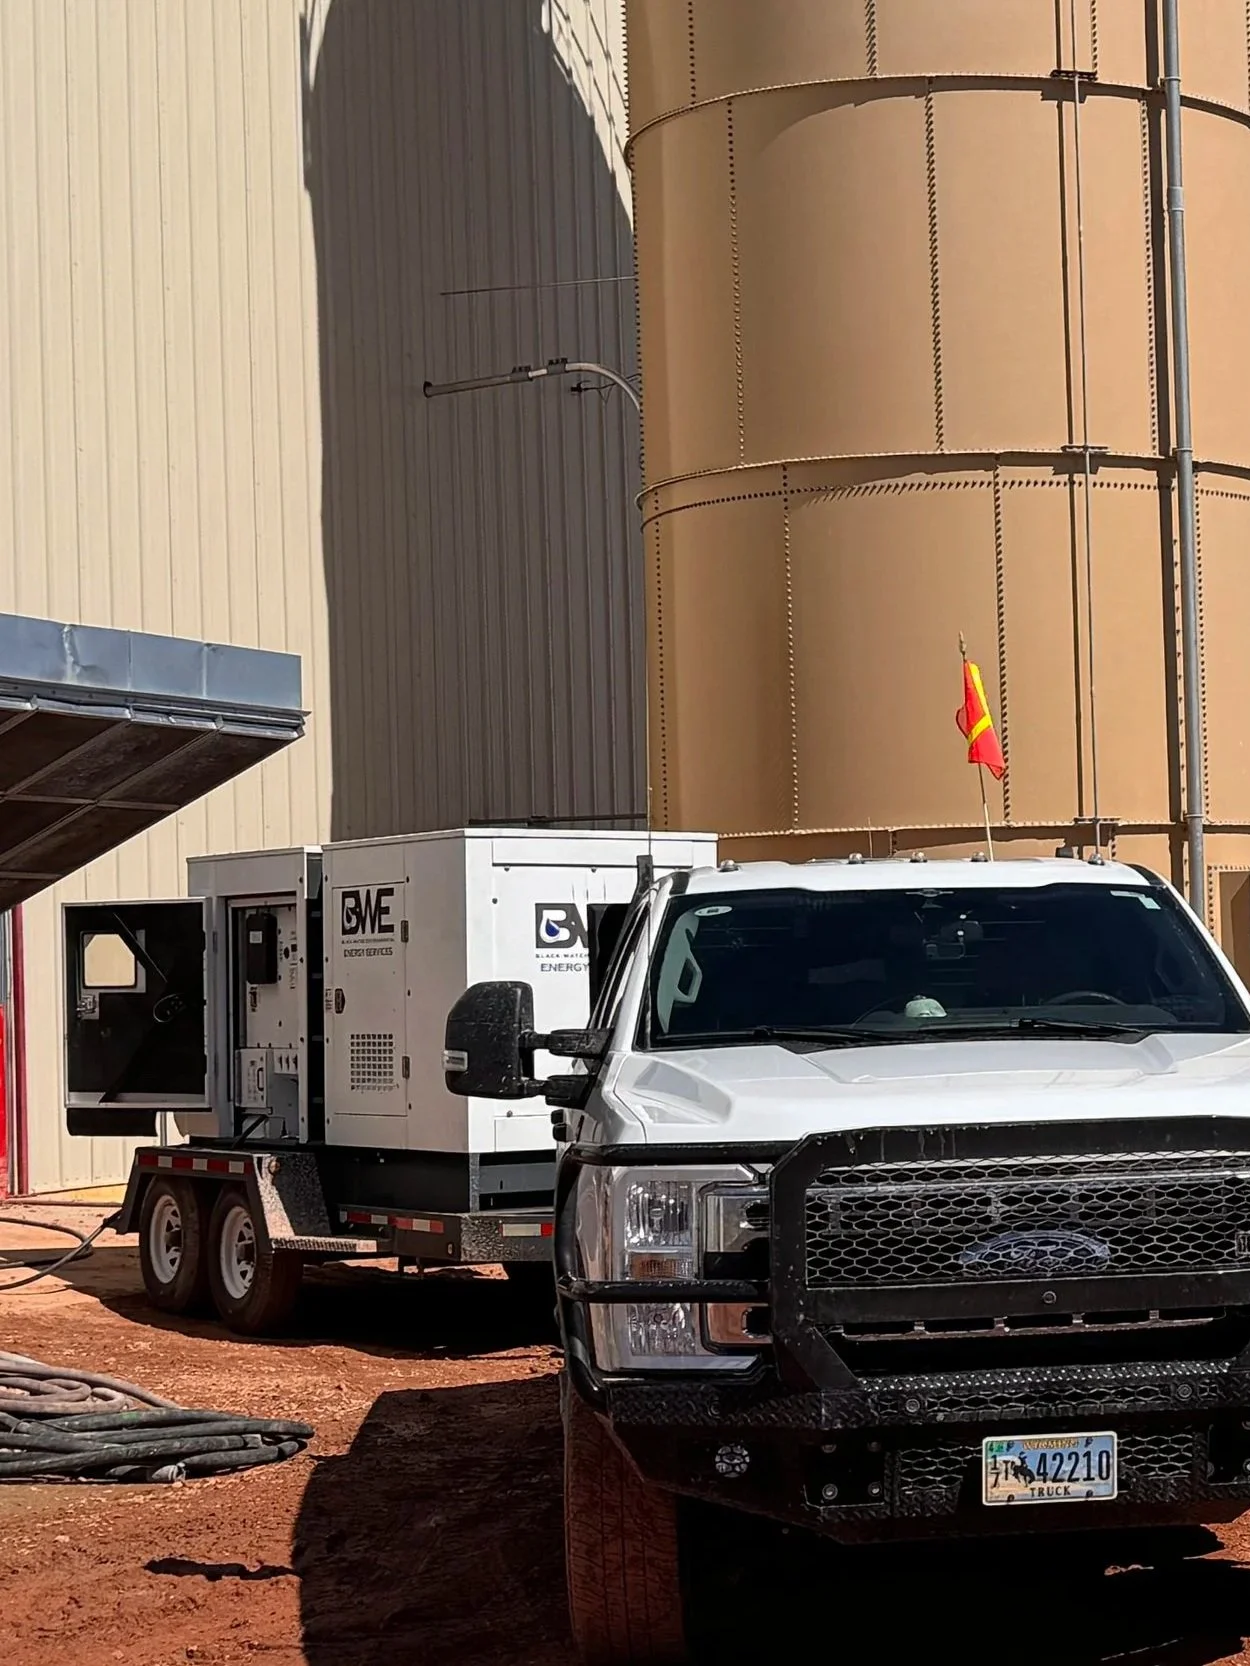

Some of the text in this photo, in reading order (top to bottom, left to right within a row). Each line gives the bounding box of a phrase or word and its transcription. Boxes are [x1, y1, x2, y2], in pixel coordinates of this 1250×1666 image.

[341, 887, 395, 936] BWE
[540, 962, 589, 972] ENERGY
[1036, 1450, 1110, 1483] 42210
[1030, 1485, 1071, 1498] TRUCK
